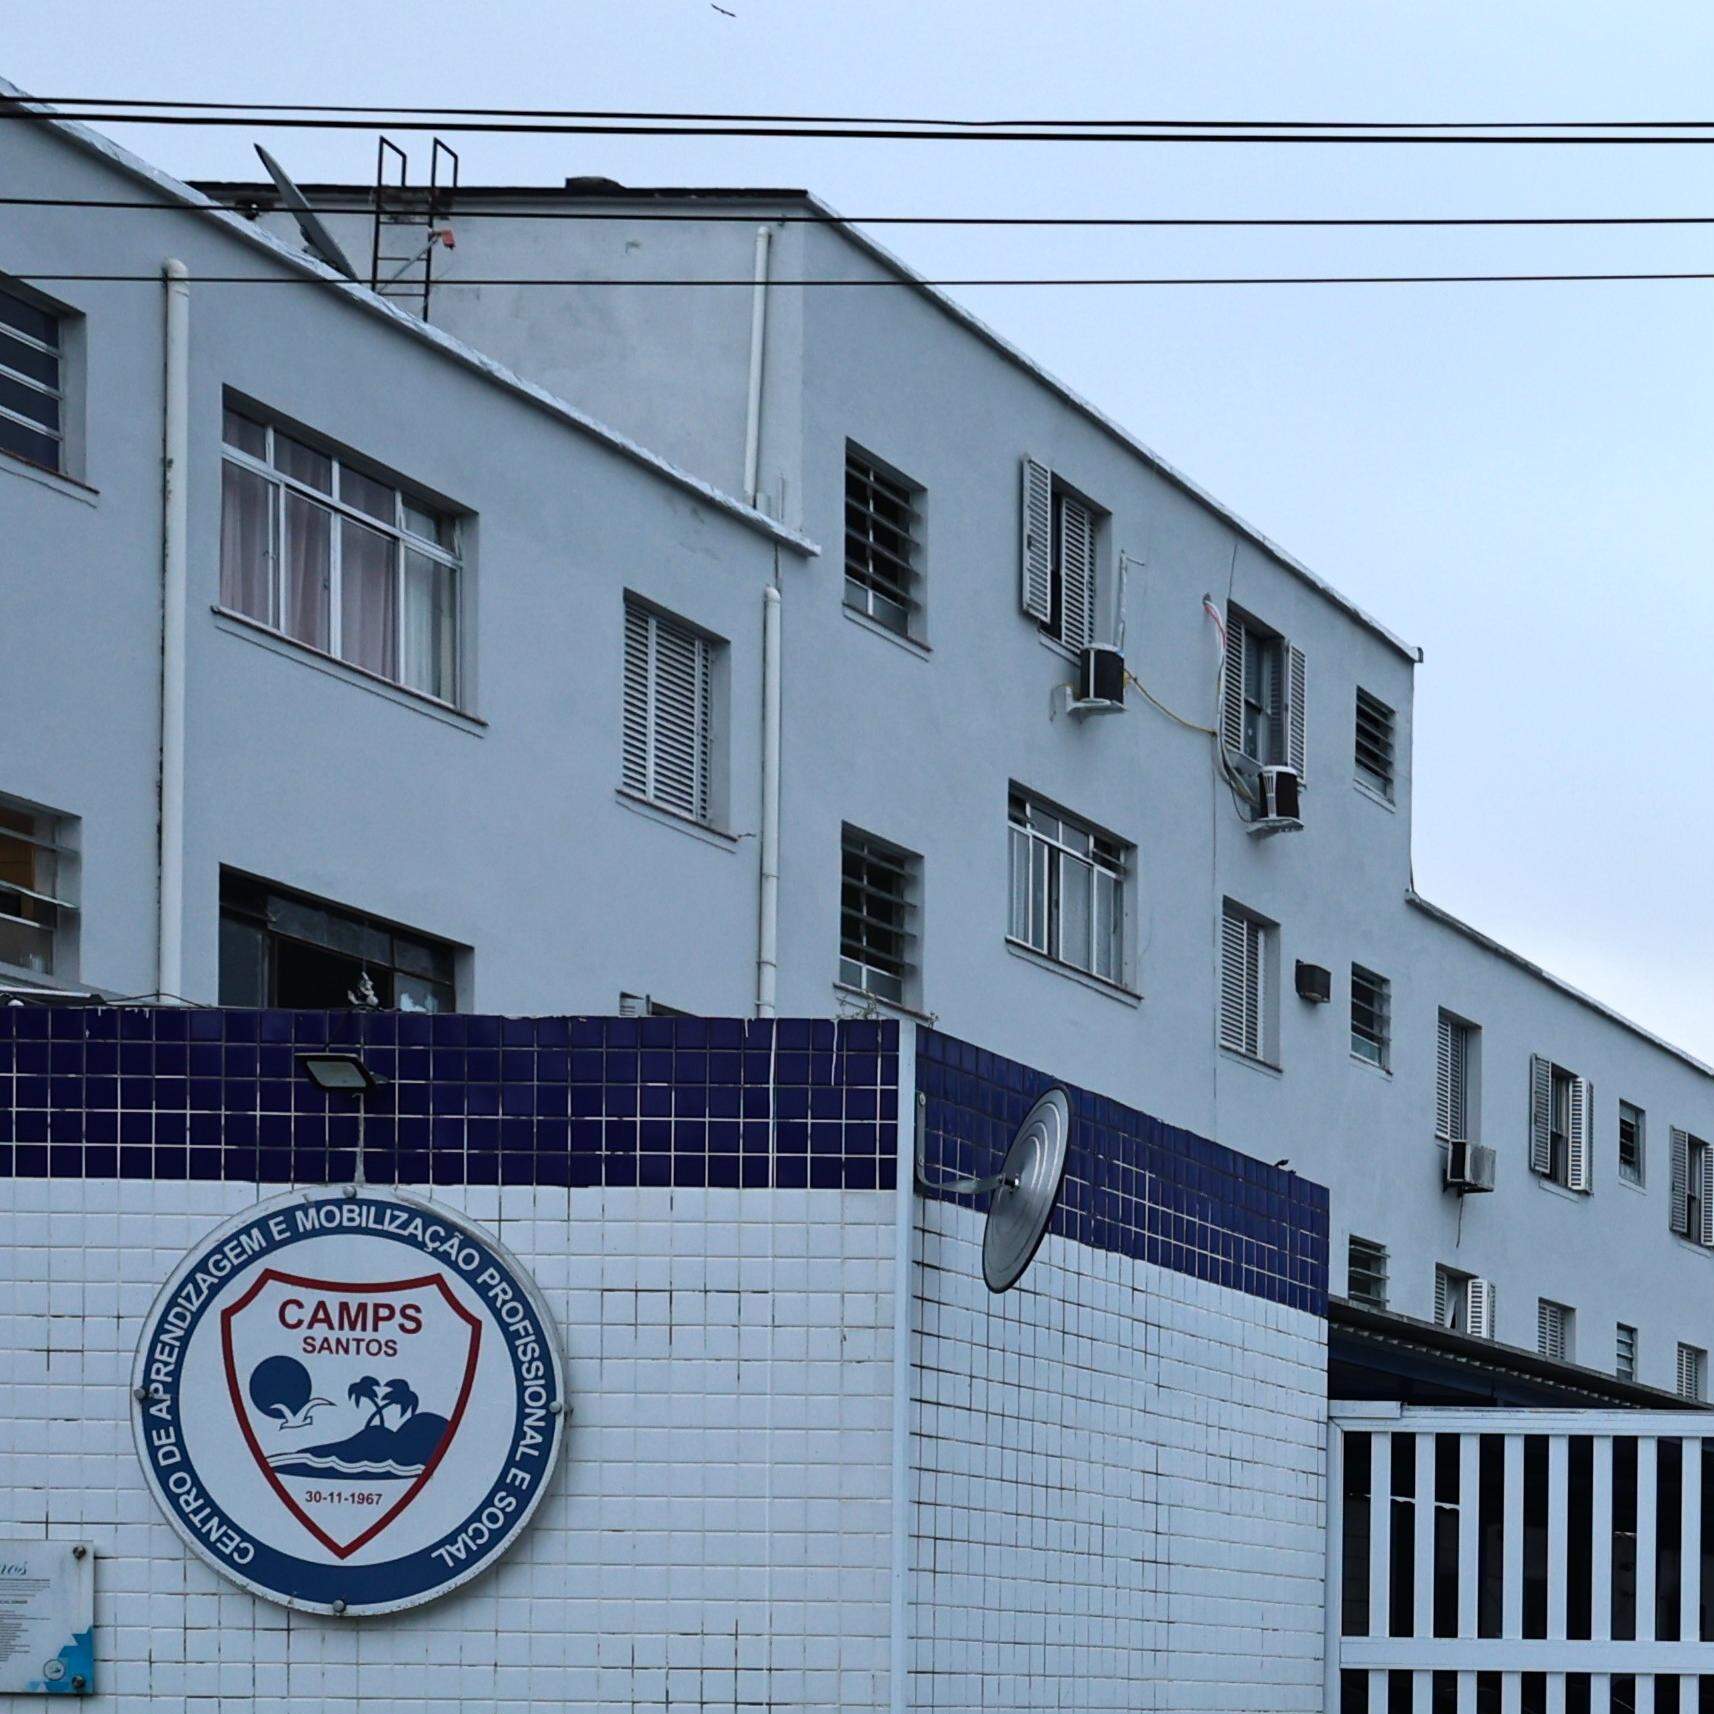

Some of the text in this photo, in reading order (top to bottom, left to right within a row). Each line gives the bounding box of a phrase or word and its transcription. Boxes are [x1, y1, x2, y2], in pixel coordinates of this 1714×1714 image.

[278, 1297, 424, 1335] CAMPS
[301, 1335, 399, 1358] SANTOS
[149, 1203, 548, 1569] CENTRO DE APRENDIZAGEM E MOBILIZAÇÃO PROFISSIONAL E SOCIAL
[304, 1490, 383, 1507] 30-11-1967
